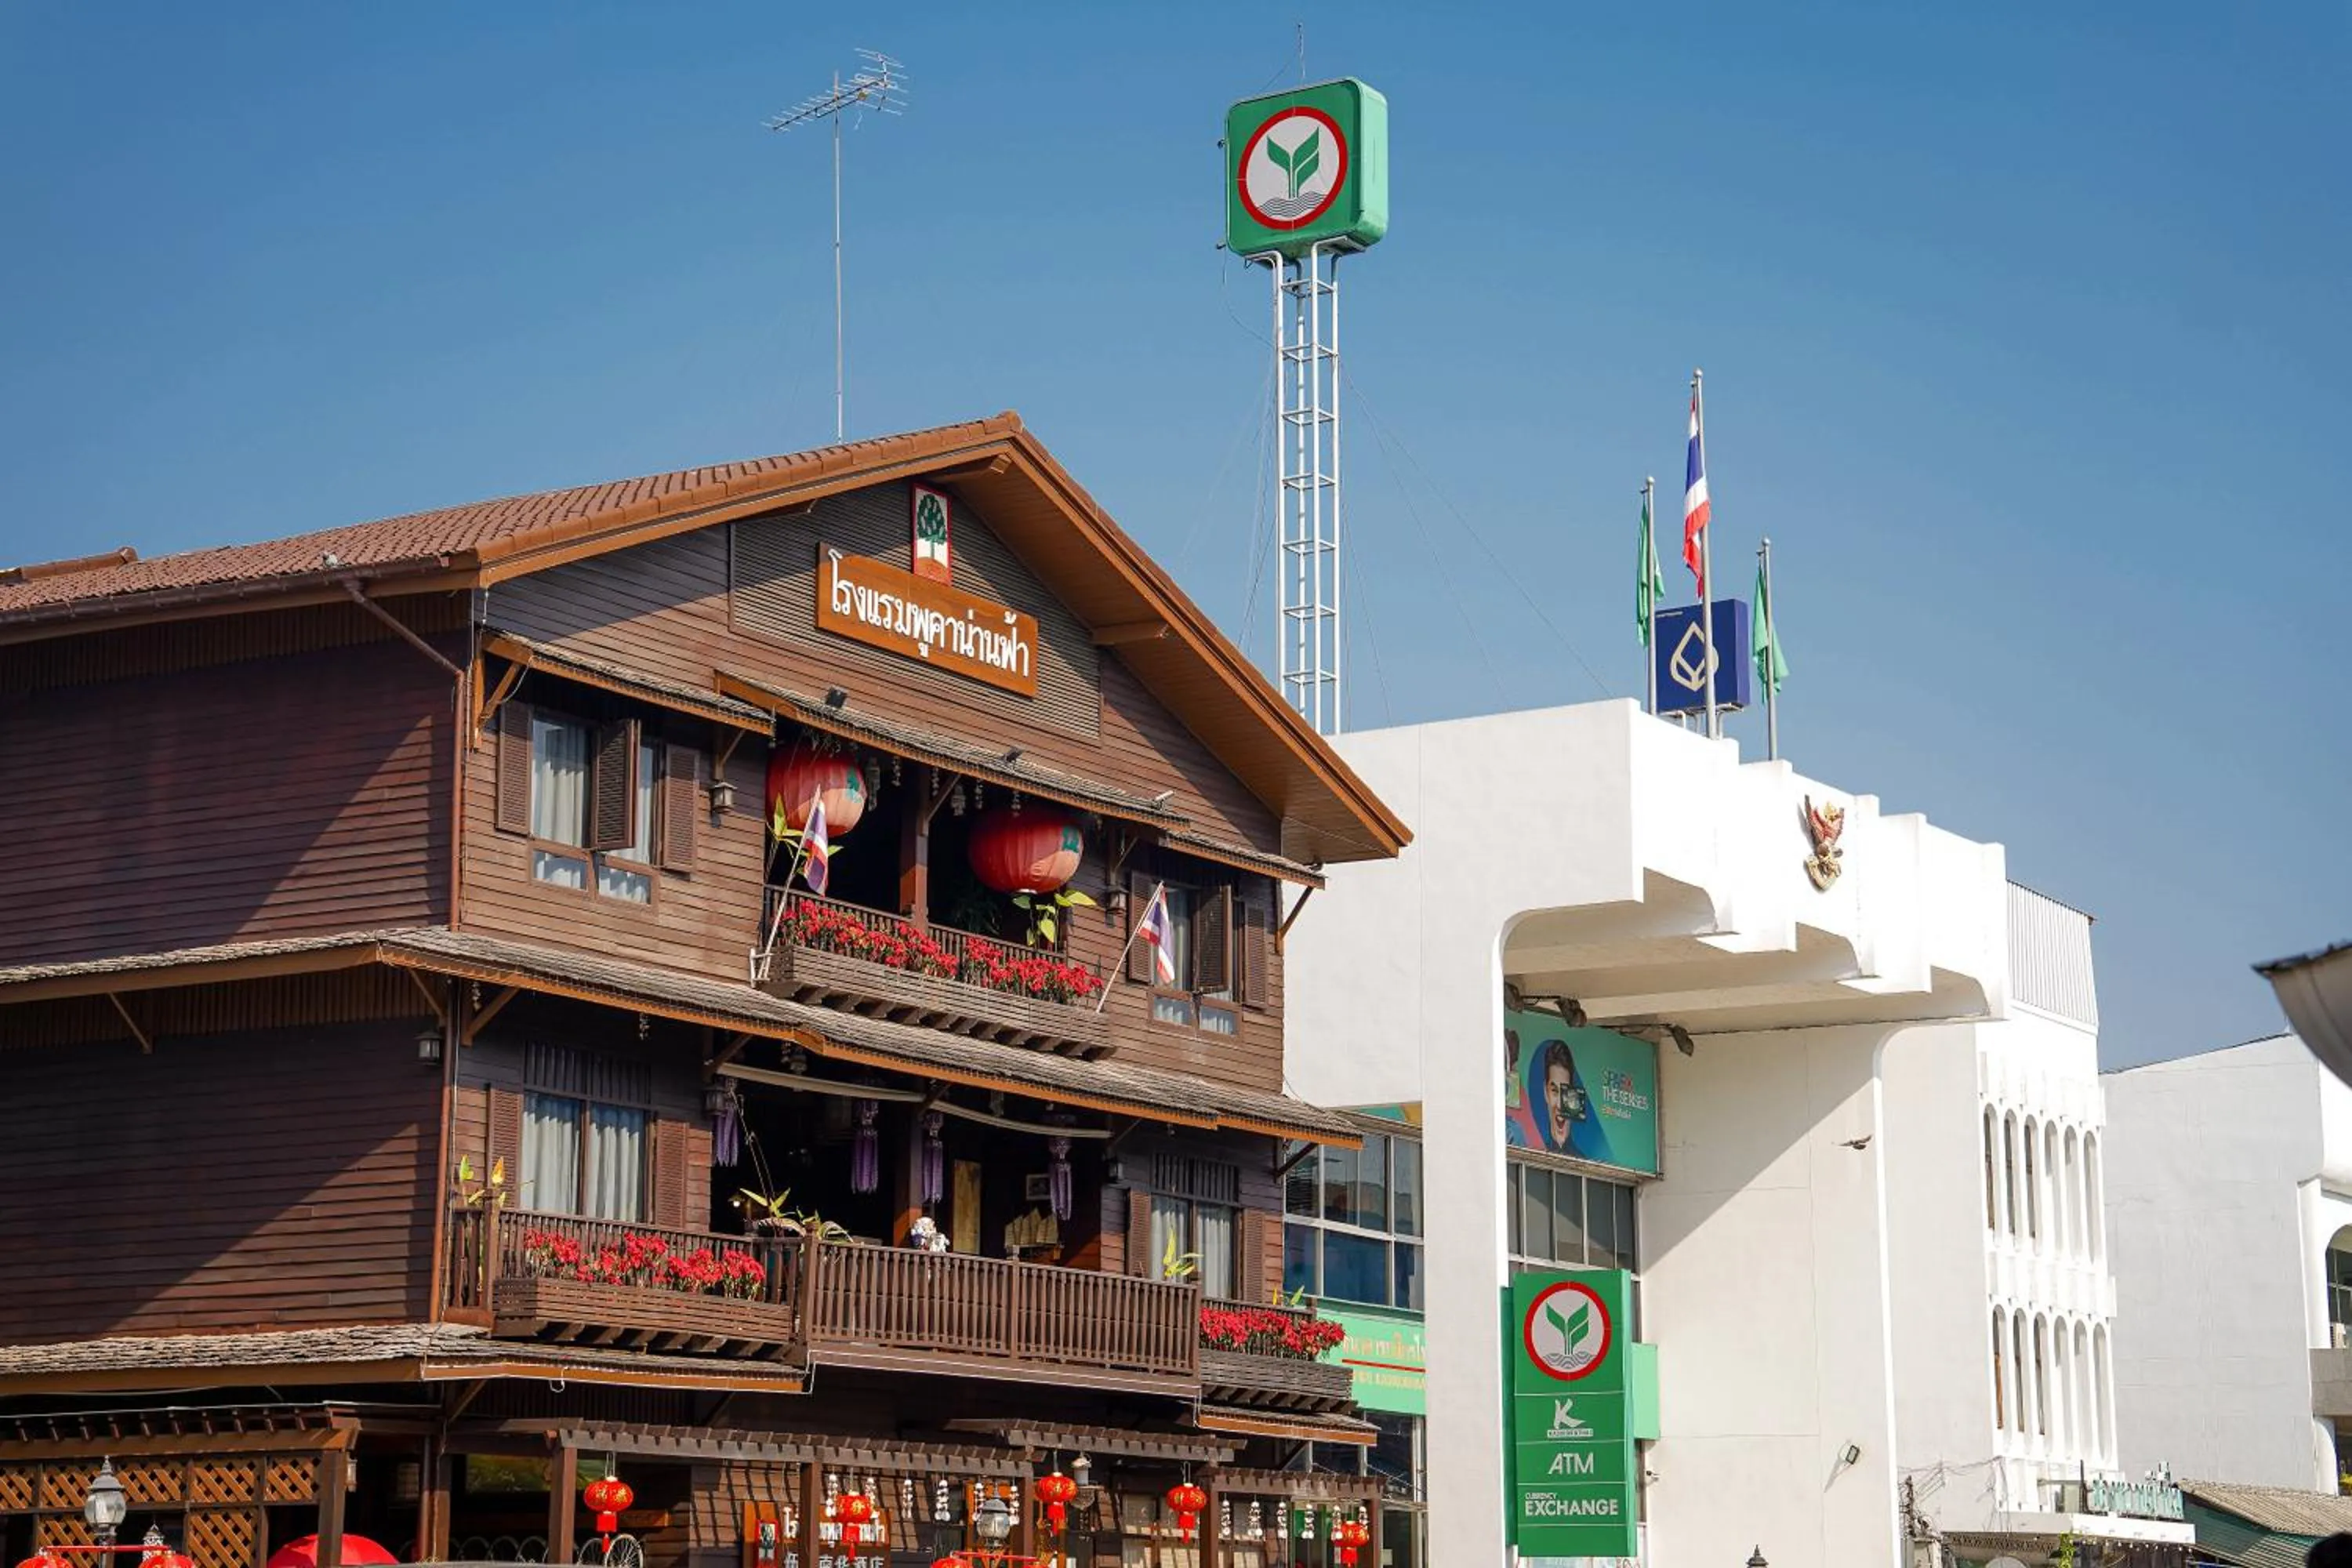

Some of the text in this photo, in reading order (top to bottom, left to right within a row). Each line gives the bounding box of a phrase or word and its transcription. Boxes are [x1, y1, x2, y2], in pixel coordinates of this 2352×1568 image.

[828, 549, 1029, 677] โรงแรมพูคาน่านฟ้า
[1548, 1452, 1594, 1475] ATM
[1525, 1498, 1619, 1516] EXCHANGE
